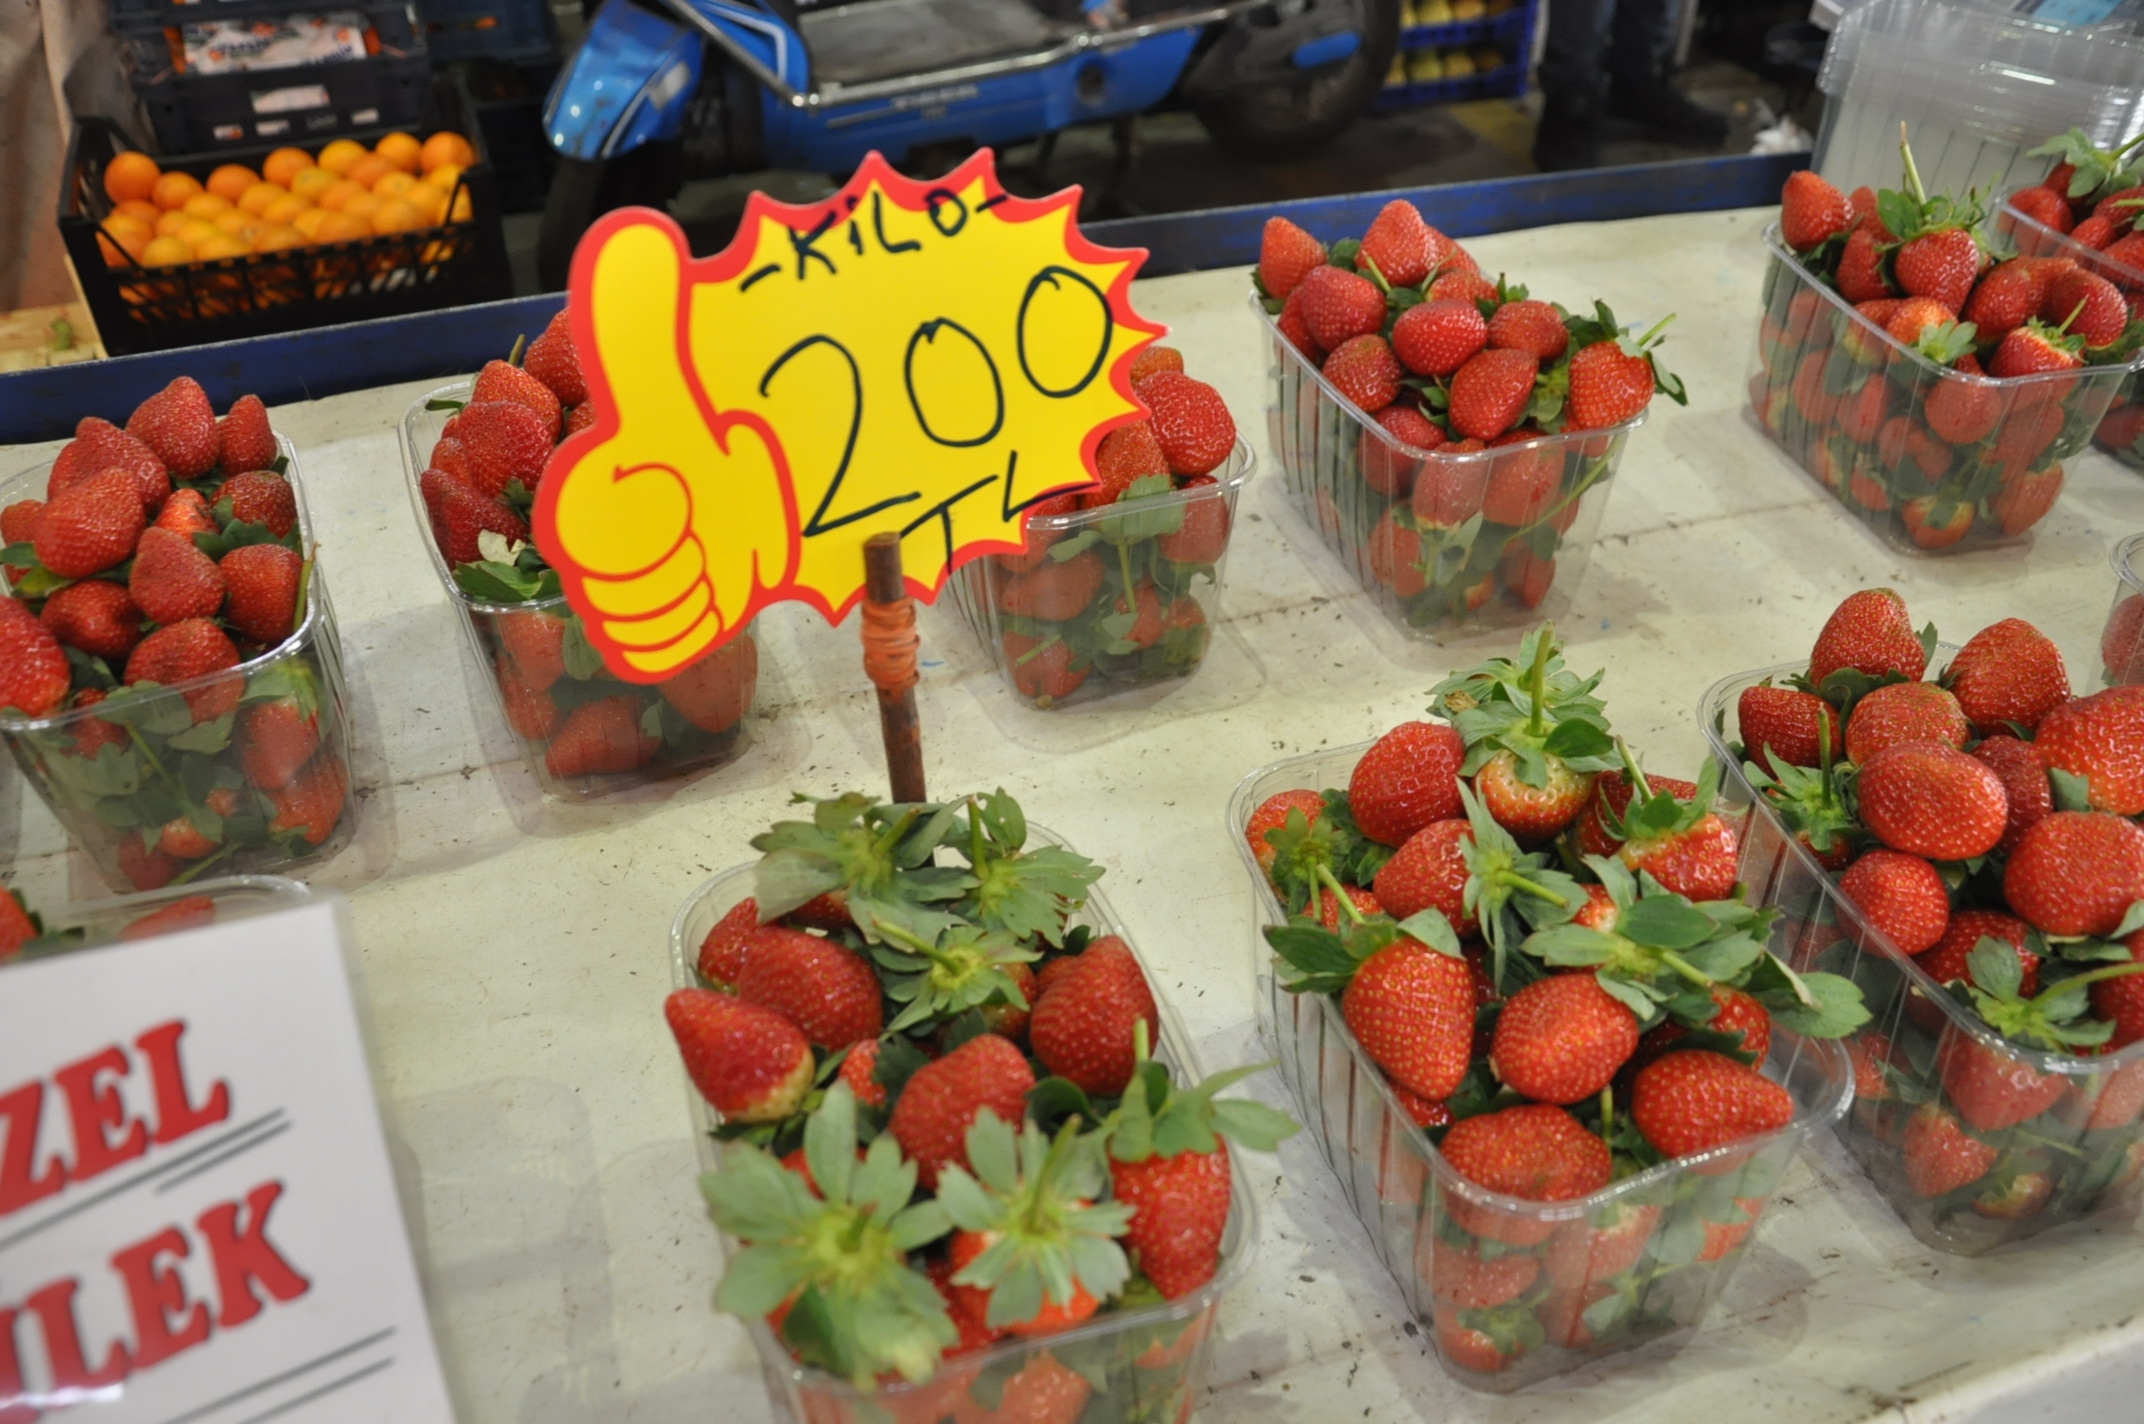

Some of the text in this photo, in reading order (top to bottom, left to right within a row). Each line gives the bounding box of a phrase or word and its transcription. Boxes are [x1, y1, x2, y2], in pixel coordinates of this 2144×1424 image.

[759, 266, 1113, 538] 200
[899, 450, 1101, 576] TL
[0, 1019, 231, 1219] ZEL
